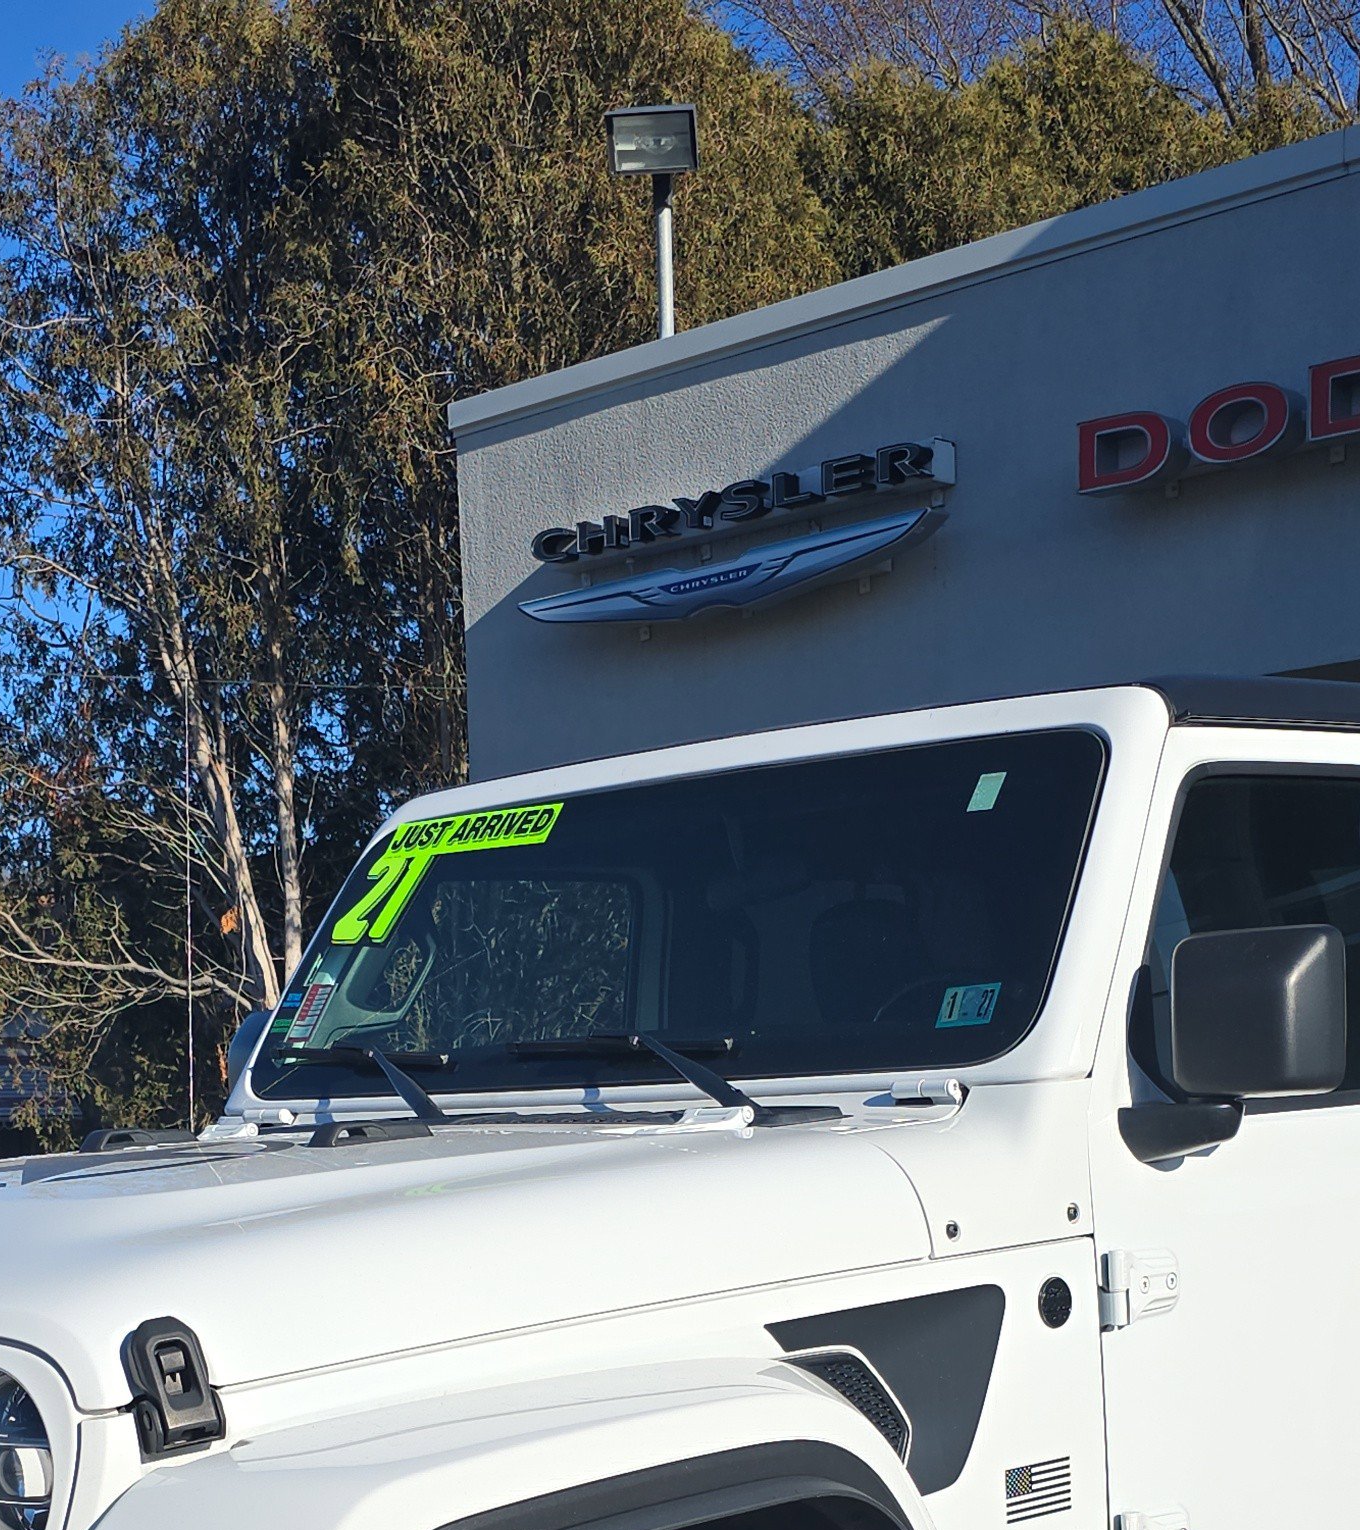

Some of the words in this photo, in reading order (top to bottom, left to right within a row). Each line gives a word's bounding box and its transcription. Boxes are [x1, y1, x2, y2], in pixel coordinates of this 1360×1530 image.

[530, 442, 934, 563] CHRYSLER
[670, 569, 747, 593] CHRYSLER
[390, 818, 457, 852] JUST
[446, 807, 557, 846] ARRIVED
[331, 853, 436, 944] 21
